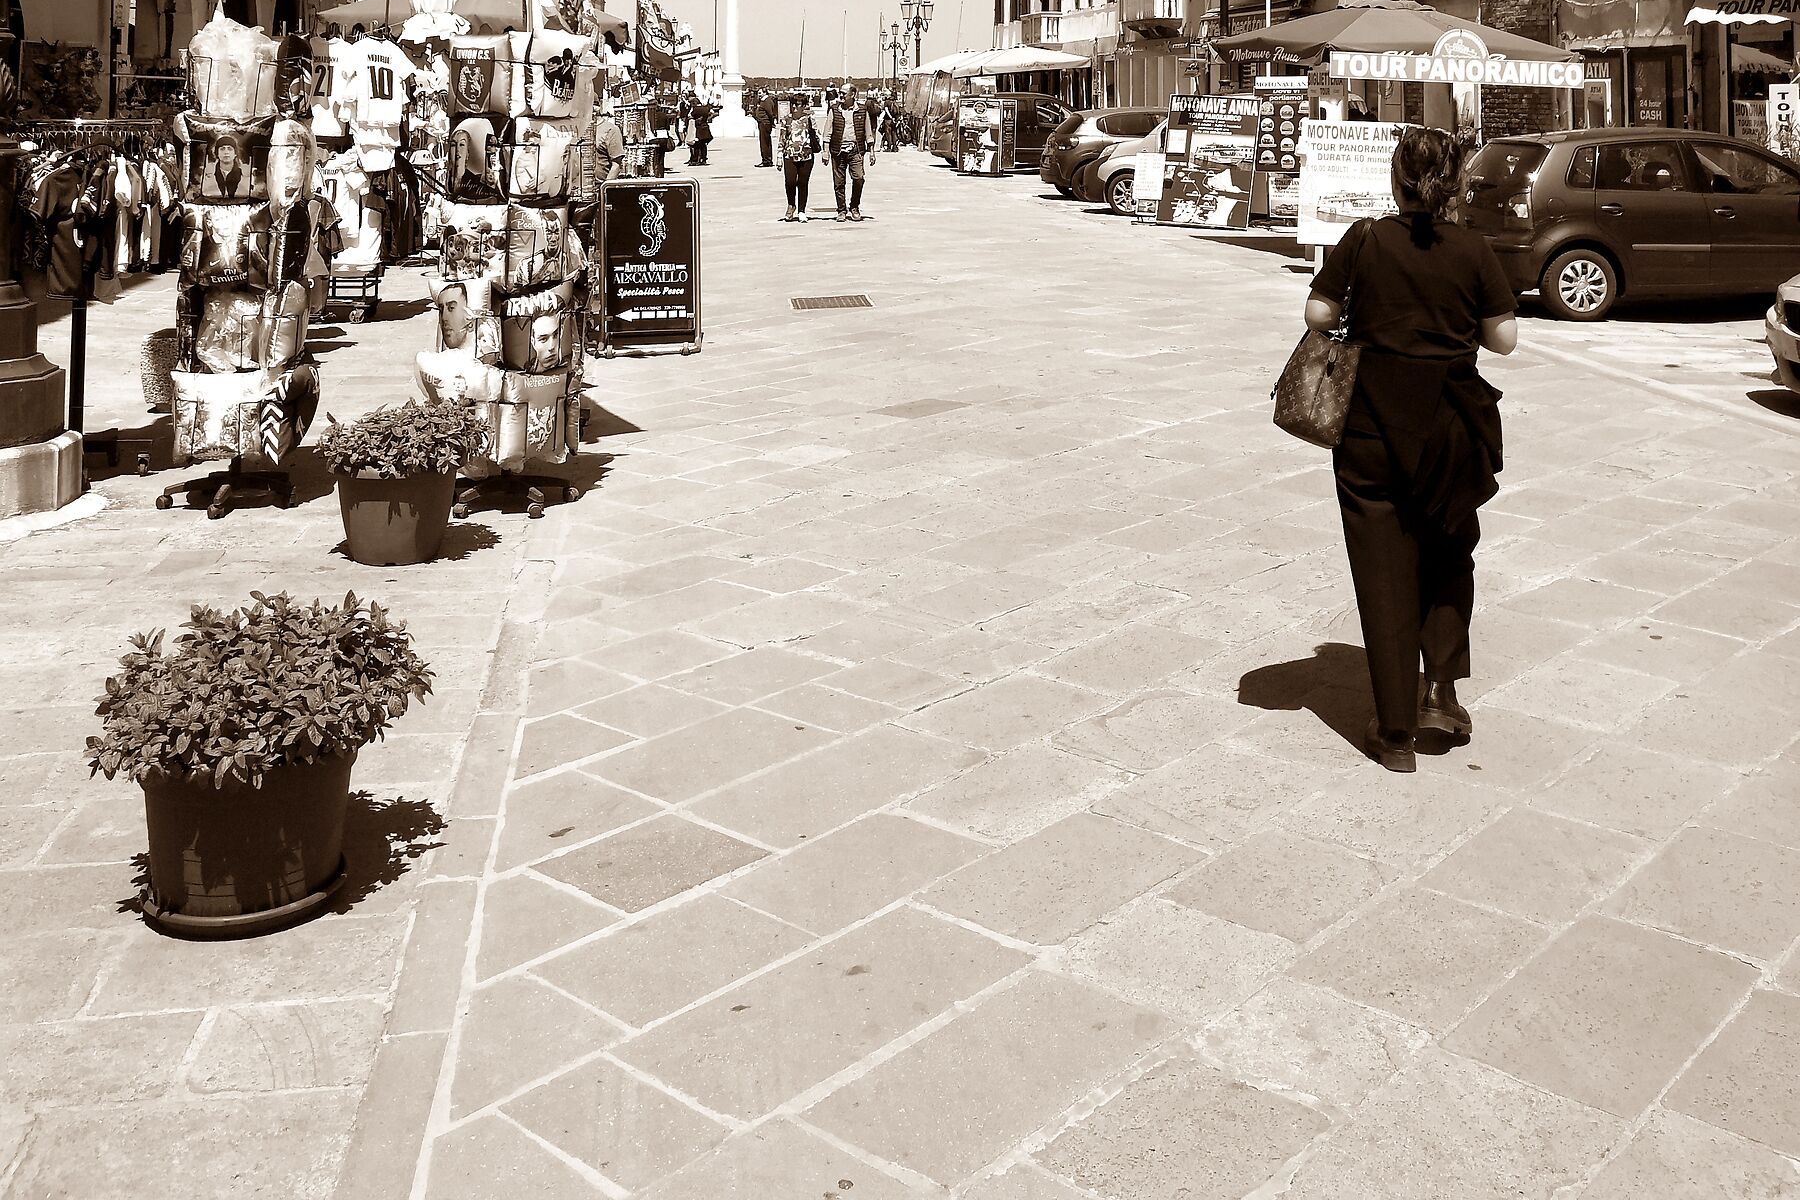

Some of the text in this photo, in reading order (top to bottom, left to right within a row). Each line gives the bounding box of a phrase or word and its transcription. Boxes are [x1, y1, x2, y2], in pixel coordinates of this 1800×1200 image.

[1716, 0, 1766, 14] TOUR
[1273, 46, 1301, 63] Anna
[1332, 53, 1584, 86] TOUR PANORAMICO
[1586, 62, 1610, 79] ATM
[313, 64, 334, 98] 21
[368, 65, 393, 101] 10
[1171, 96, 1259, 117] MOTONAVE ANNA
[1640, 99, 1648, 107] 24
[1188, 112, 1203, 120] TOUR
[1640, 109, 1662, 121] CASH
[1307, 124, 1369, 141] MOTONAVE
[1311, 142, 1394, 155] TOUR PANORAMIC
[1317, 152, 1352, 162] DURATA
[1367, 156, 1392, 164] minut
[632, 270, 688, 284] CAVALLO
[662, 286, 685, 296] Pesce
[524, 375, 560, 388] Netherlands
